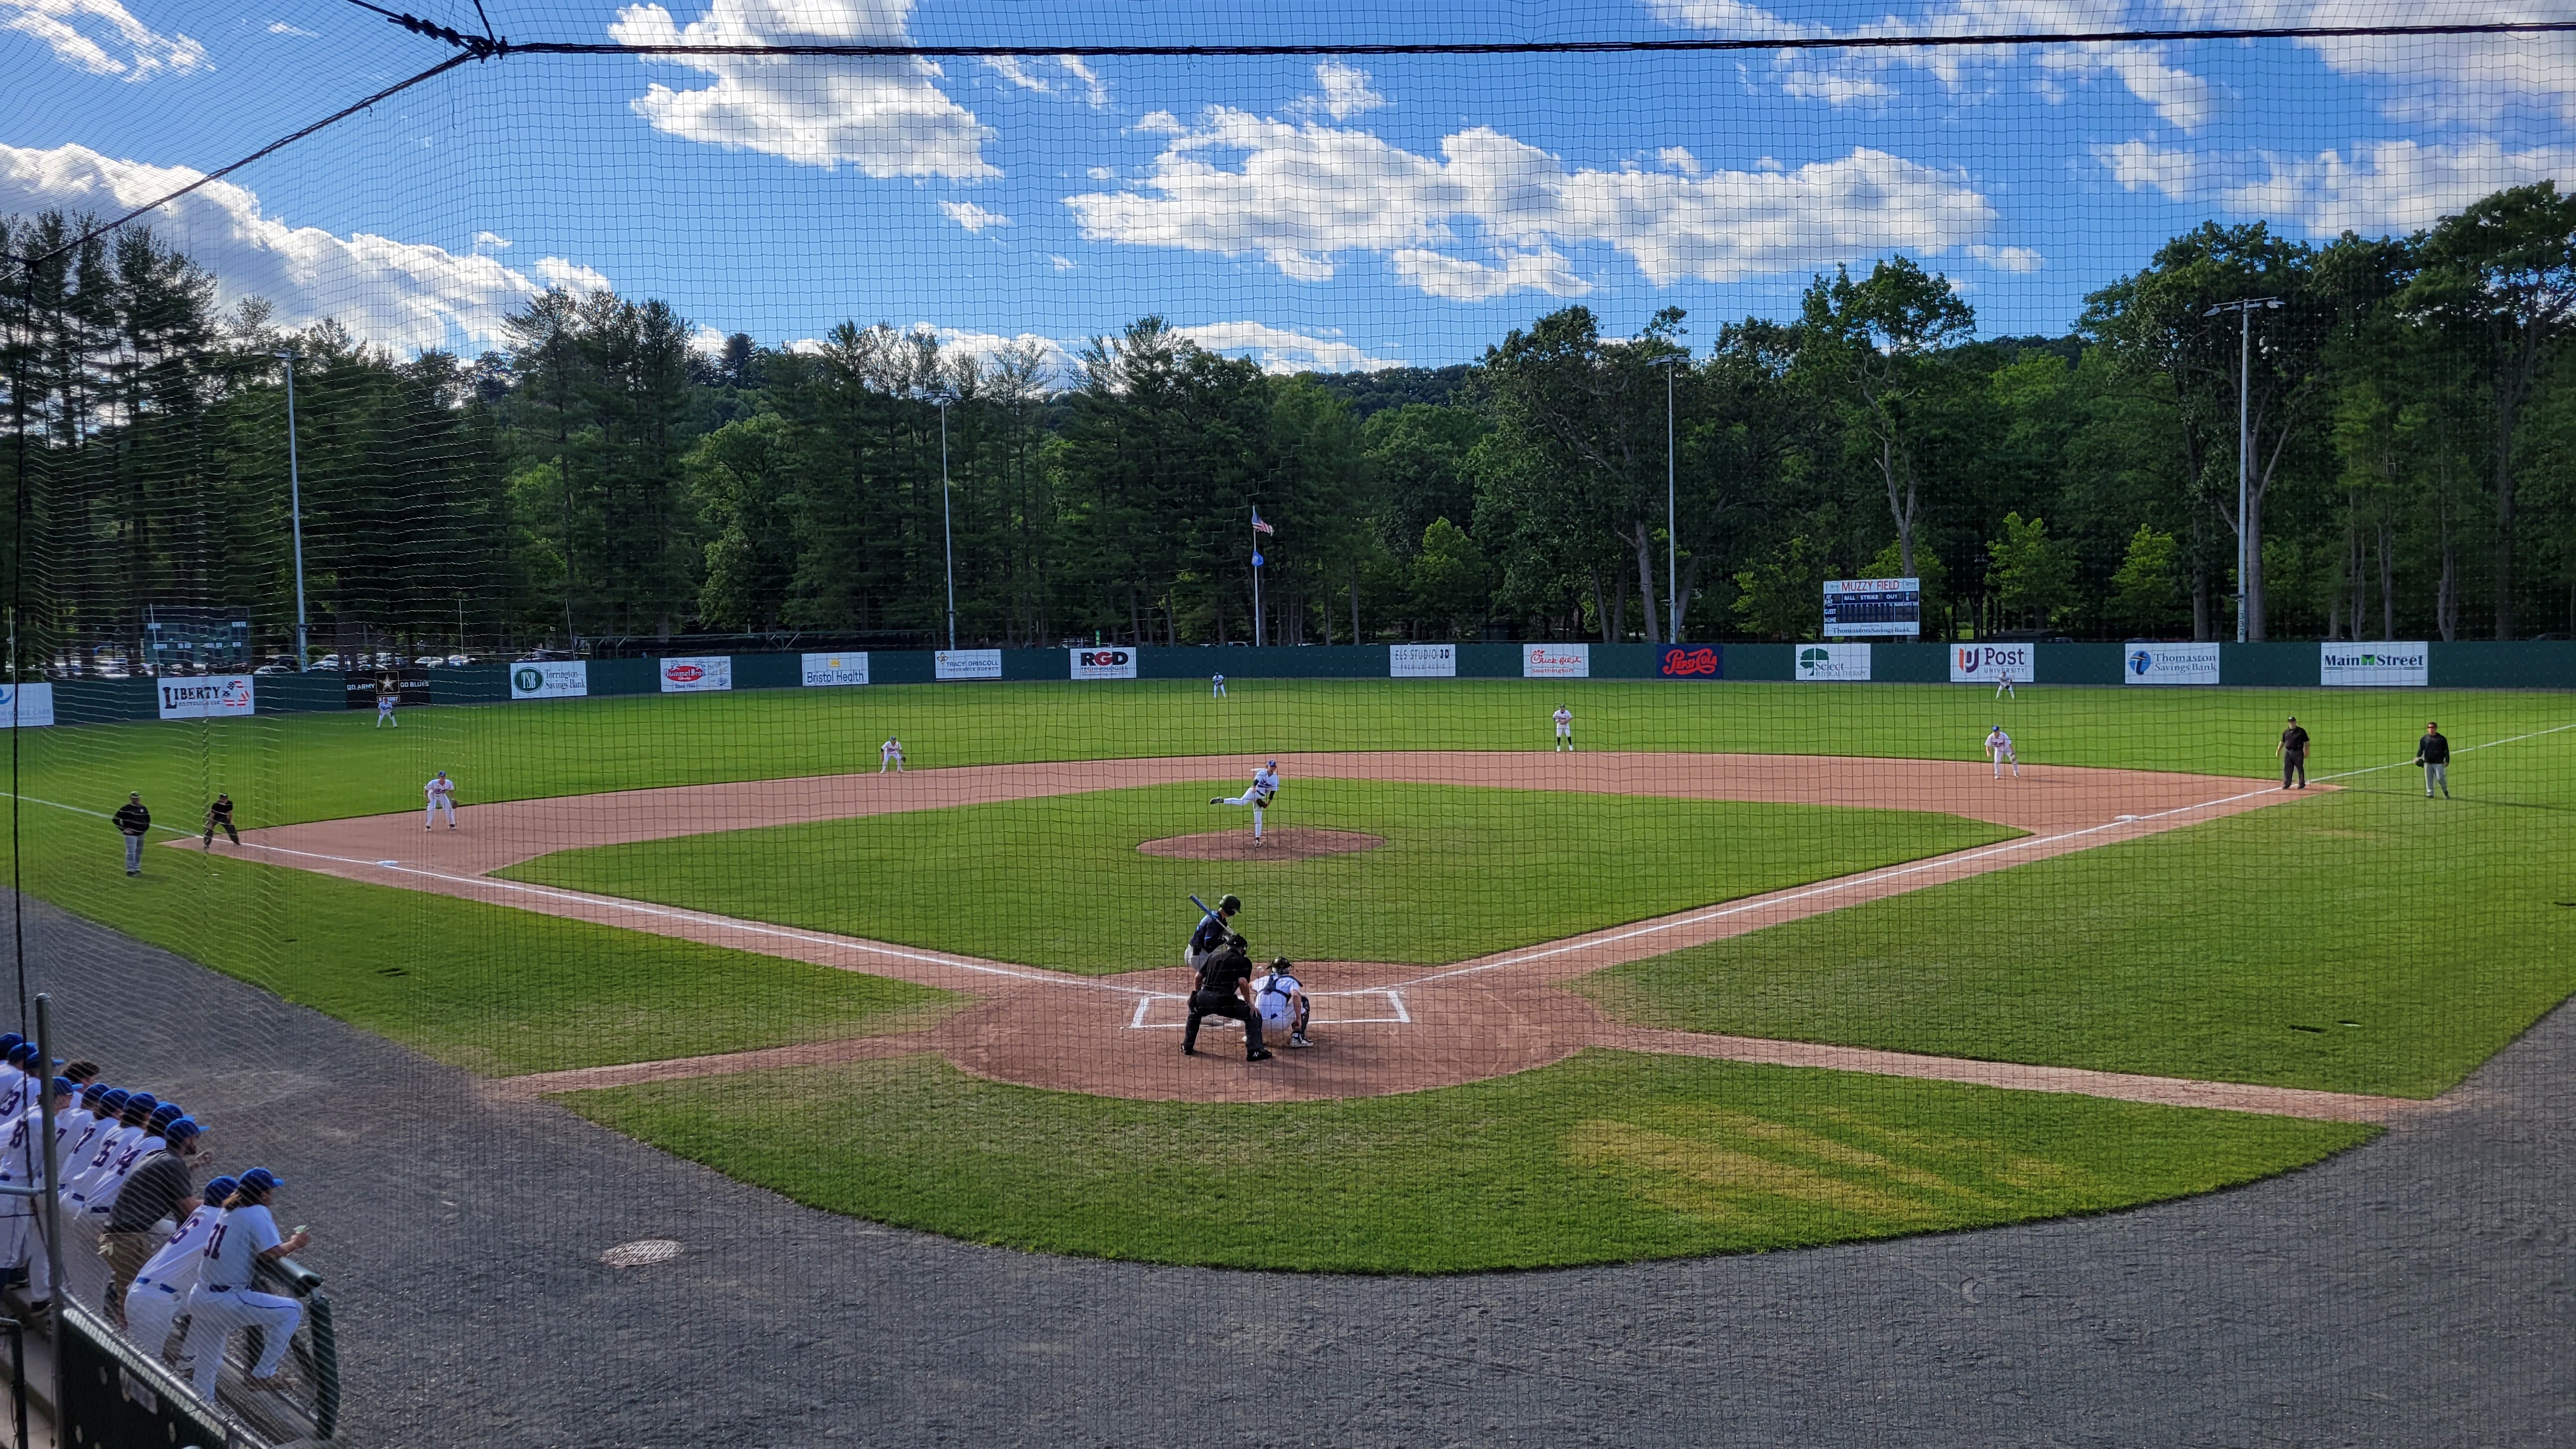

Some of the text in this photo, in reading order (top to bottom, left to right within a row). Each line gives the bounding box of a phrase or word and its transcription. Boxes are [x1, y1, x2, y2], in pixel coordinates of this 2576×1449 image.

[1842, 580, 1899, 592] MUZZY FIELD
[1871, 626, 1894, 634] Savings
[1080, 652, 1129, 666] RGD
[1395, 649, 1449, 660] ELS STUDIO 3D
[1984, 647, 2025, 665] Post
[2154, 652, 2216, 662] Thomaston
[2324, 654, 2423, 666] Main Street
[1815, 661, 1844, 671] Select
[2155, 663, 2216, 673] Savings Bank
[521, 672, 536, 689] TSB
[544, 669, 578, 681] Torrington
[807, 670, 864, 683] Bristol Health
[545, 678, 585, 692] Savings Bank
[162, 686, 220, 709] LIBERTY
